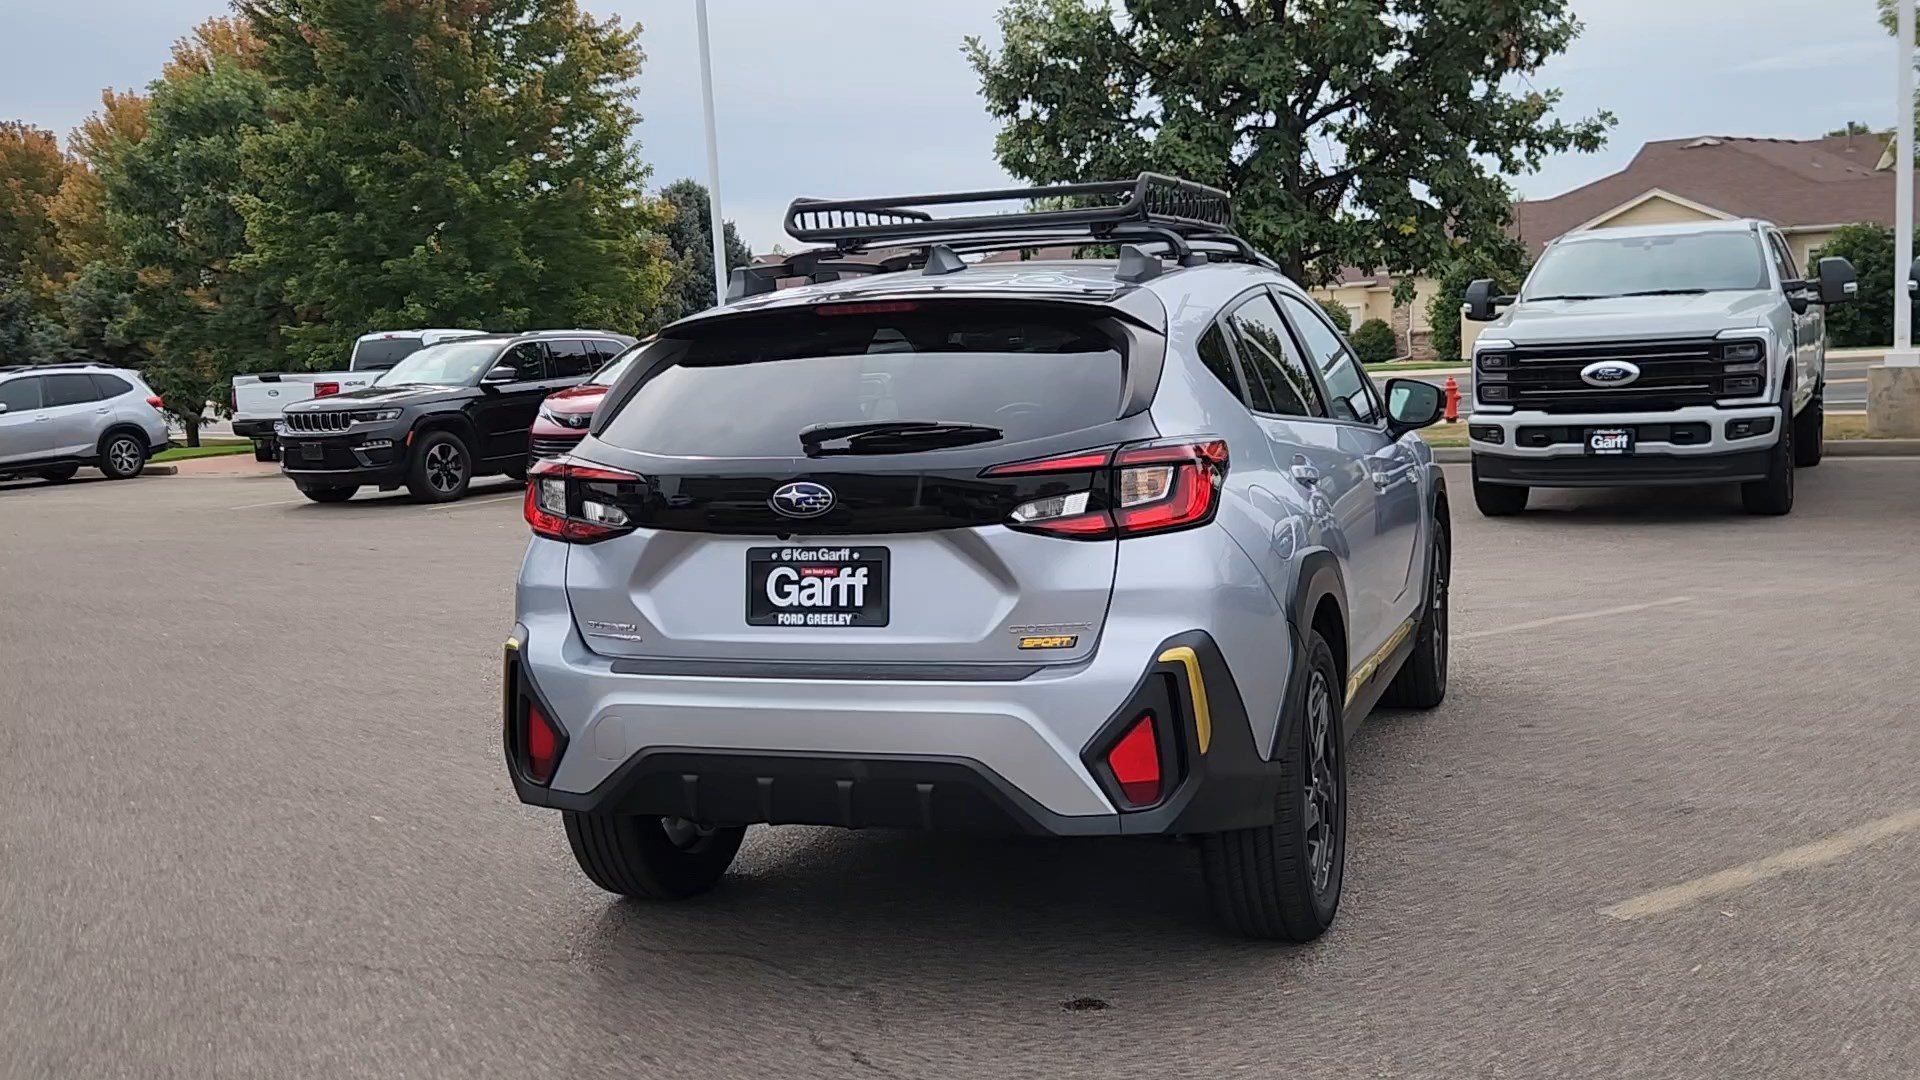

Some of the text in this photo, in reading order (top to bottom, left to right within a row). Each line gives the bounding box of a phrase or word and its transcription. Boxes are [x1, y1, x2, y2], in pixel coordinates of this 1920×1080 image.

[1591, 435, 1628, 449] Garff
[793, 549, 817, 561] Ken
[818, 549, 850, 561] Garff
[766, 566, 868, 607] Garff
[778, 613, 852, 625] FORD GREELEY
[1022, 637, 1071, 648] SPORT
